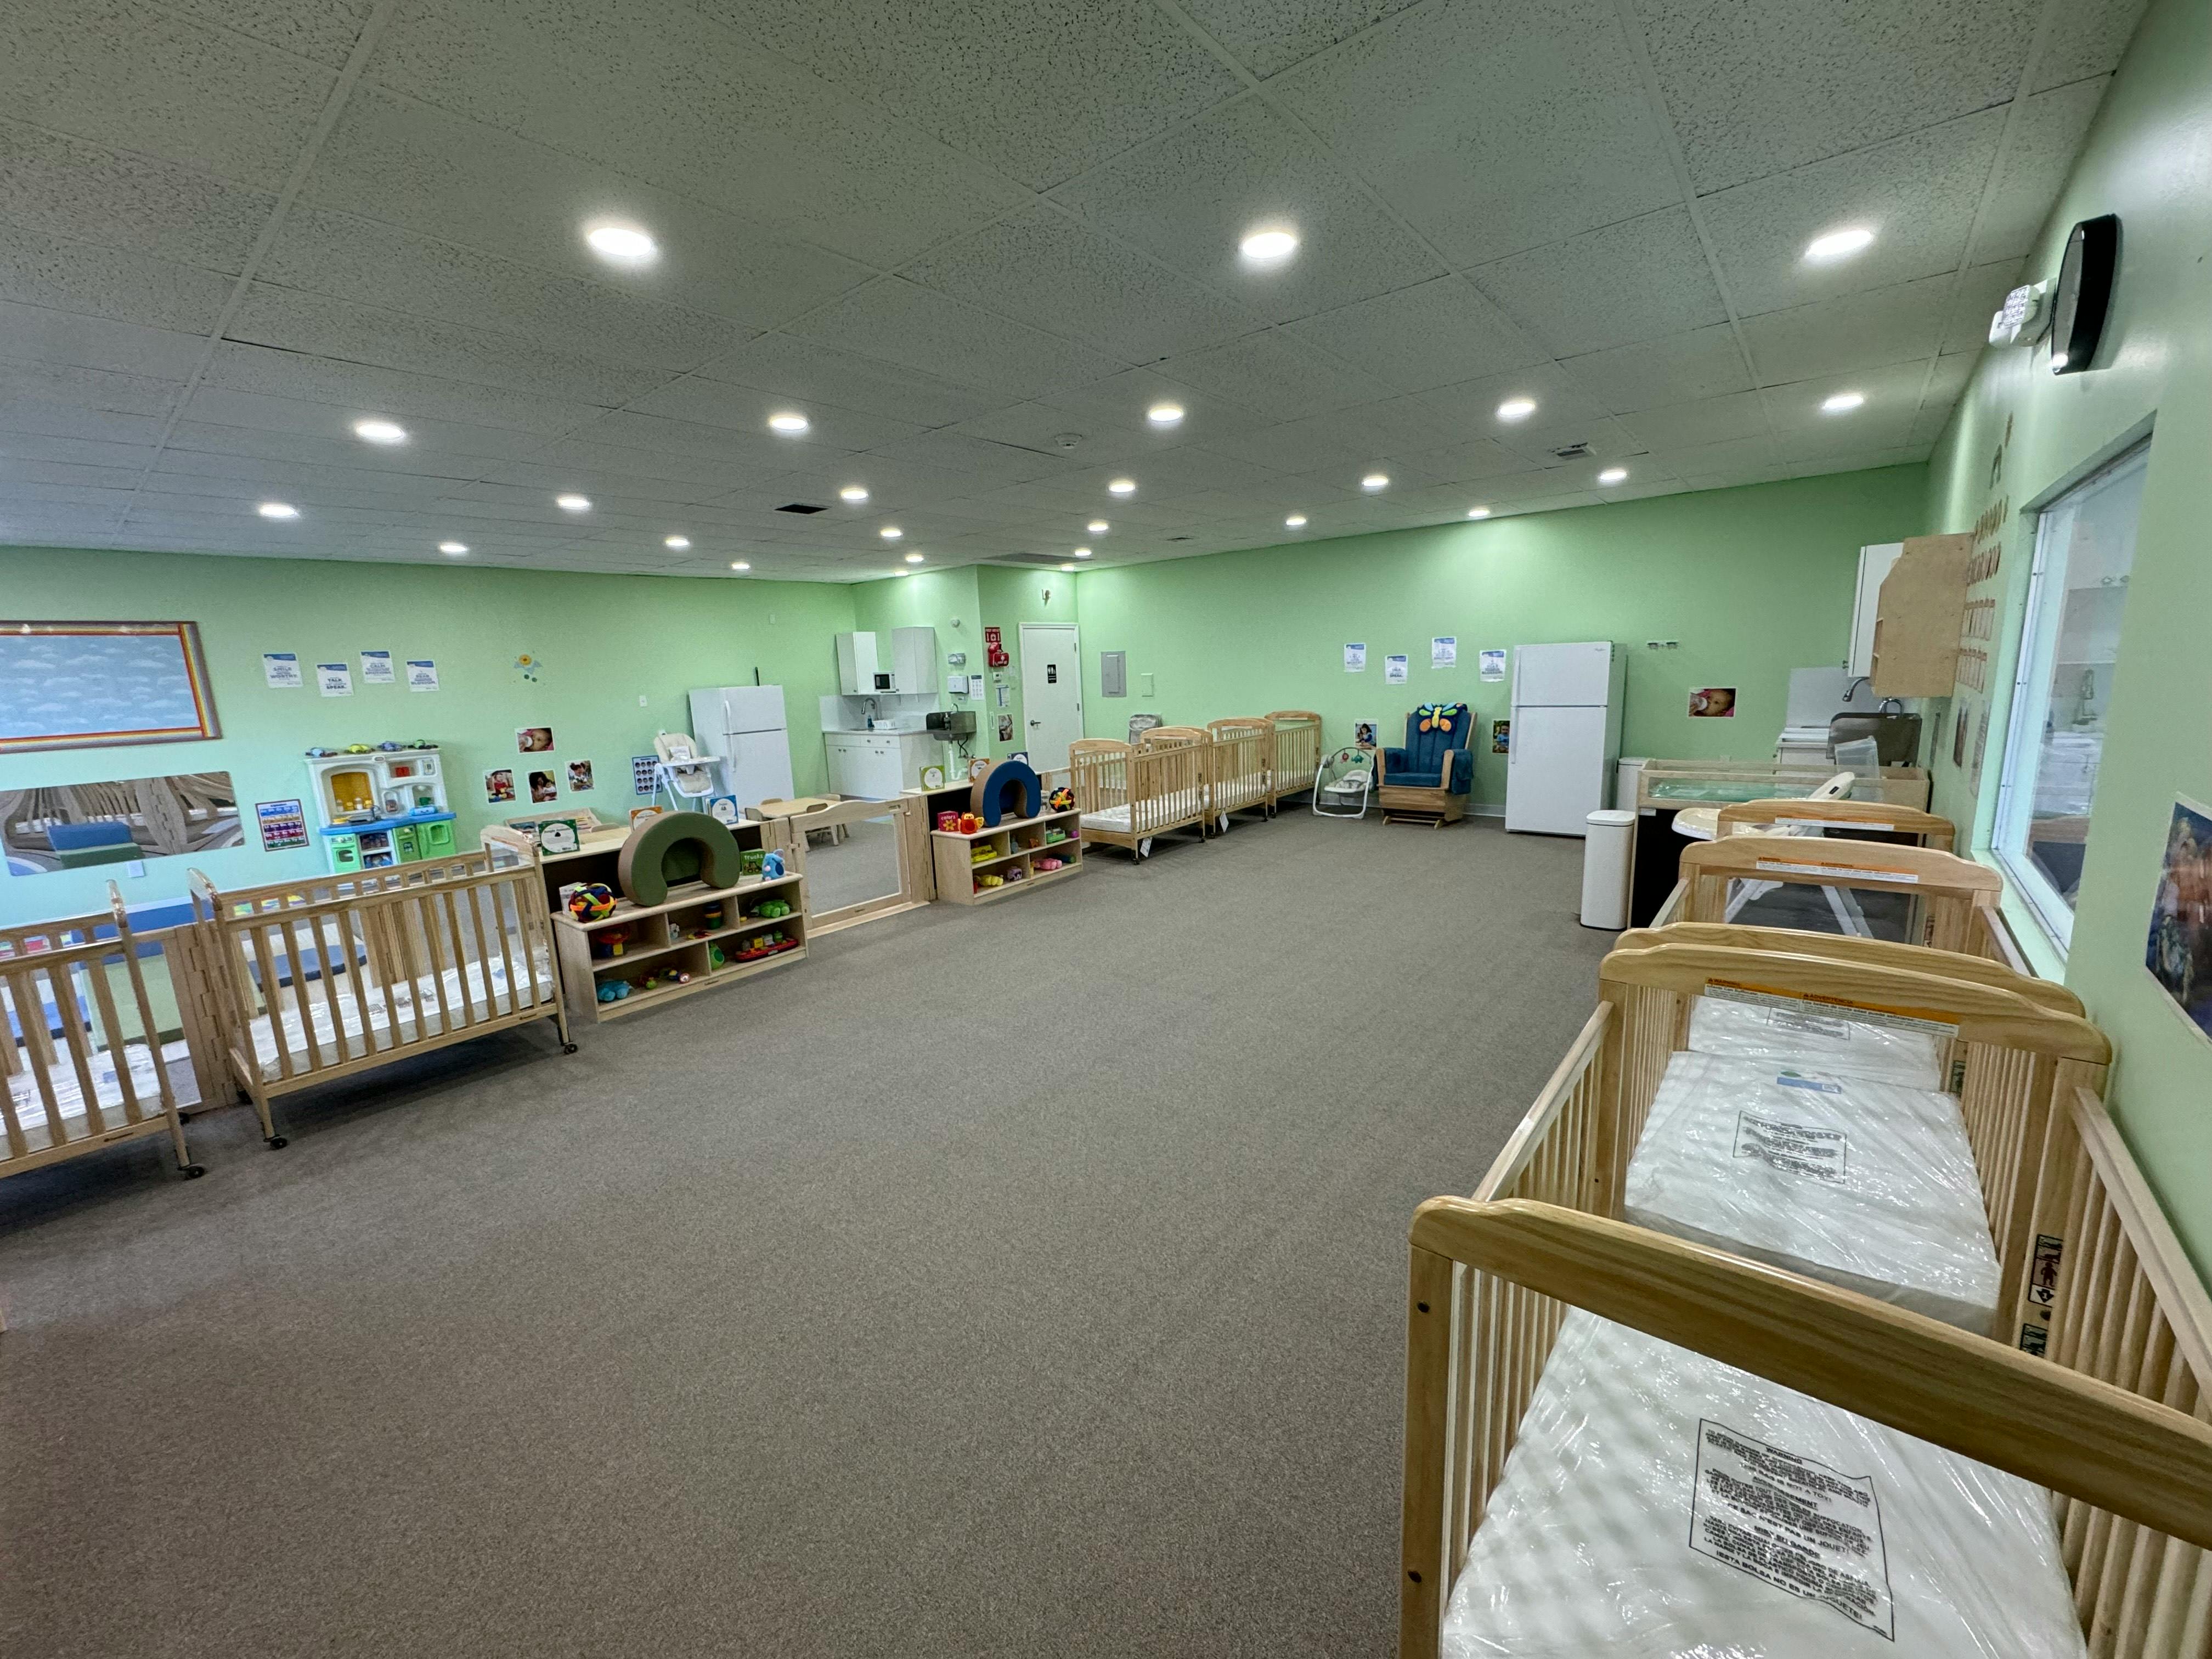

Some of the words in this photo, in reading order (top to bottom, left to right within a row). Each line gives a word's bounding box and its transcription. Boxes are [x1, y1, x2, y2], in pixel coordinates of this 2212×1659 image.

[1765, 1447, 1802, 1465] WARNING
[1723, 1540, 1746, 1554] BOLSA
[1803, 1535, 1815, 1544] UN
[1817, 1539, 1849, 1555] JOUET!
[1742, 1561, 1771, 1580] BOLSA
[1773, 1576, 1786, 1587] NO
